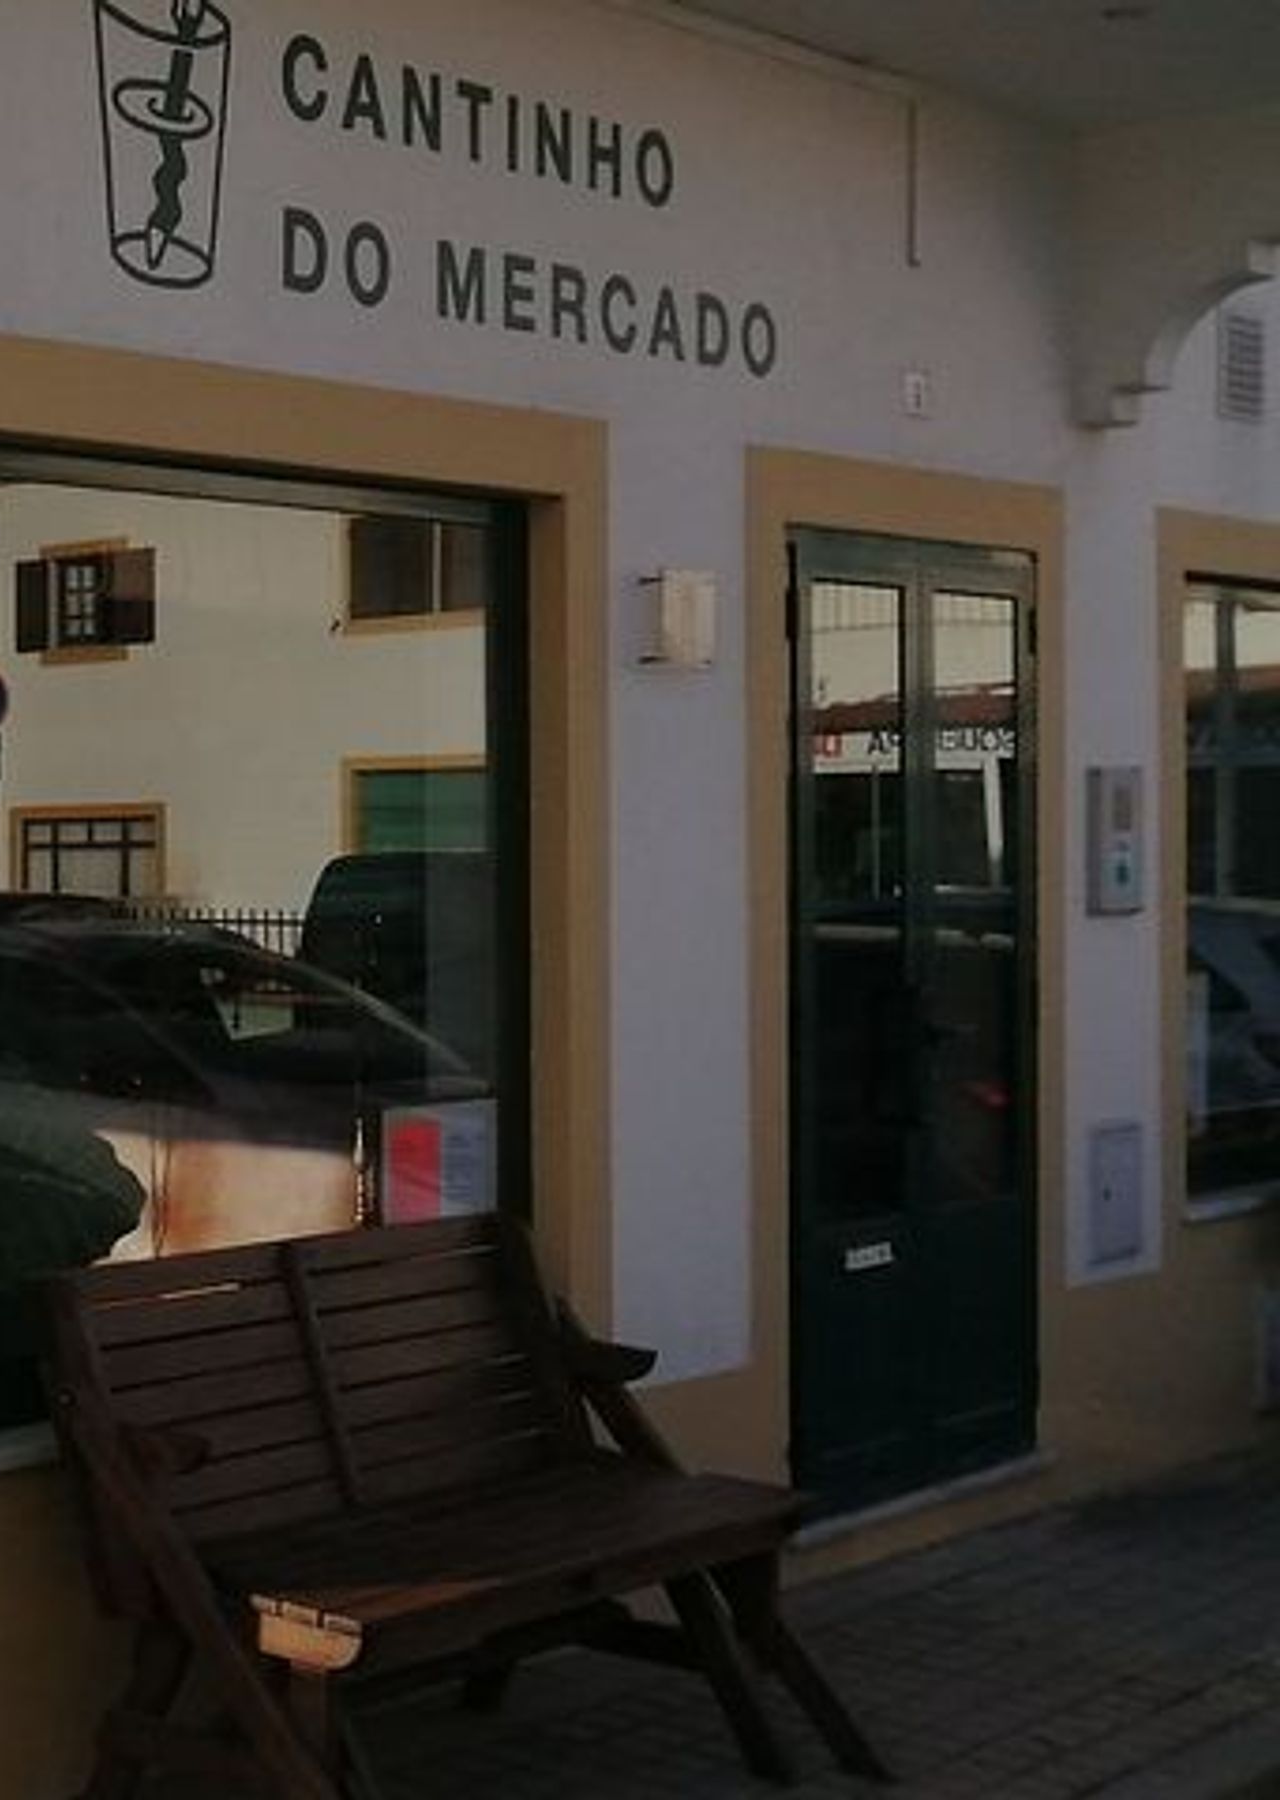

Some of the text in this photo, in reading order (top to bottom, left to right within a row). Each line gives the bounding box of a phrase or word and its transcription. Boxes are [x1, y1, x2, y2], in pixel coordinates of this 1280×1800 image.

[281, 33, 674, 208] CANTINHO
[281, 206, 777, 378] DO MERCADO
